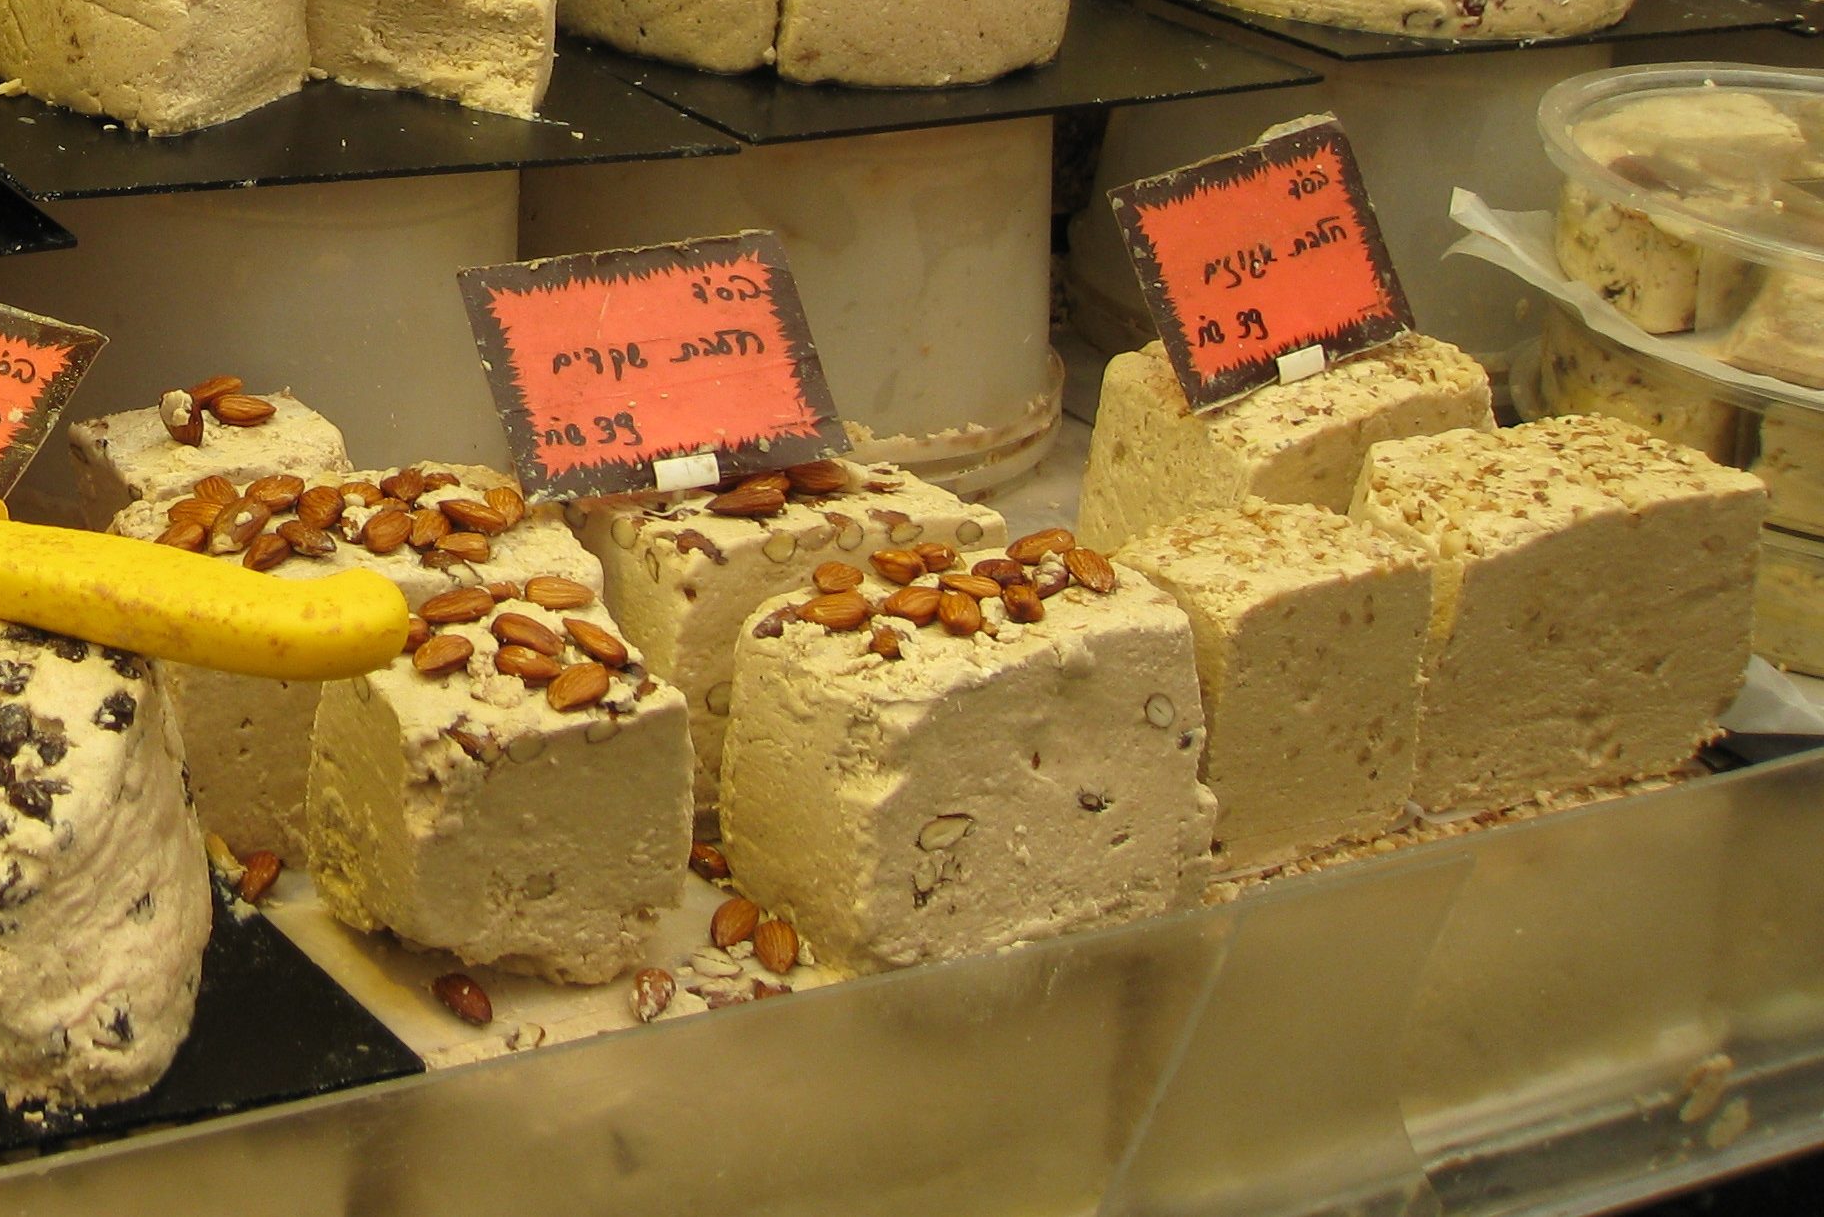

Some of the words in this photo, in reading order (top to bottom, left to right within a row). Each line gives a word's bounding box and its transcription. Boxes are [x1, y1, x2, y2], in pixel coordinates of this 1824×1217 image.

[1287, 215, 1347, 257] חלבת
[1203, 243, 1277, 288] אגוזים
[1236, 308, 1269, 340] 39
[551, 342, 649, 381] שקדים
[669, 330, 766, 364] חלבת
[594, 412, 643, 447] 39
